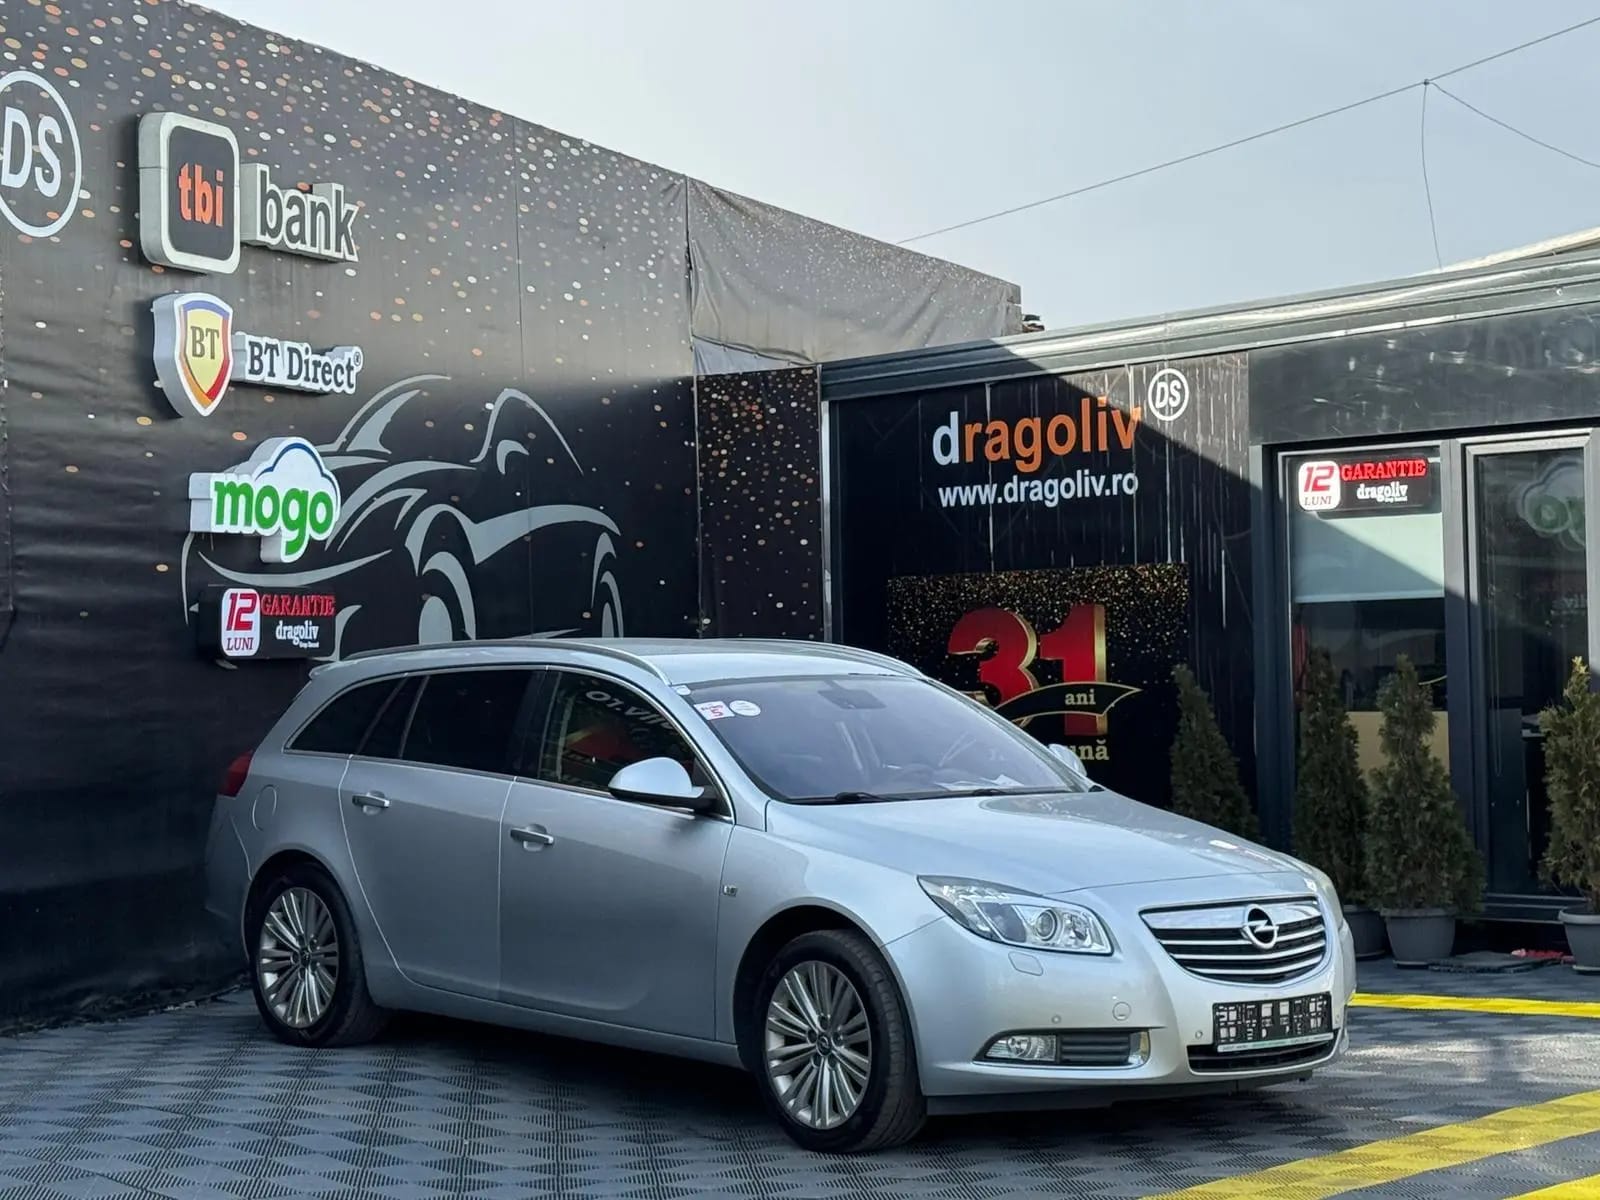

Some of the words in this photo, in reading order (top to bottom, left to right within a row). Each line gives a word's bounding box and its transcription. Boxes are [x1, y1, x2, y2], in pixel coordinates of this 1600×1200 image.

[1, 106, 63, 197] DS
[178, 163, 224, 227] tbi
[258, 165, 357, 259] bank
[190, 325, 220, 361] BT
[248, 341, 280, 377] BT
[1155, 381, 1182, 408] DS
[932, 395, 1142, 473] dragoliv
[1303, 465, 1335, 493] 12
[1341, 459, 1427, 482] GARANTIE
[938, 468, 1139, 508] www.dragoliv.ro
[1304, 496, 1332, 506] LUNI
[1356, 481, 1409, 503] dragoliv
[213, 480, 334, 556] mogo
[226, 592, 258, 631] 12
[260, 594, 336, 617] GARANTIE
[226, 637, 254, 651] LUNI
[275, 620, 320, 646] dragoliv
[948, 603, 1108, 737] 31
[1064, 688, 1096, 706] ani
